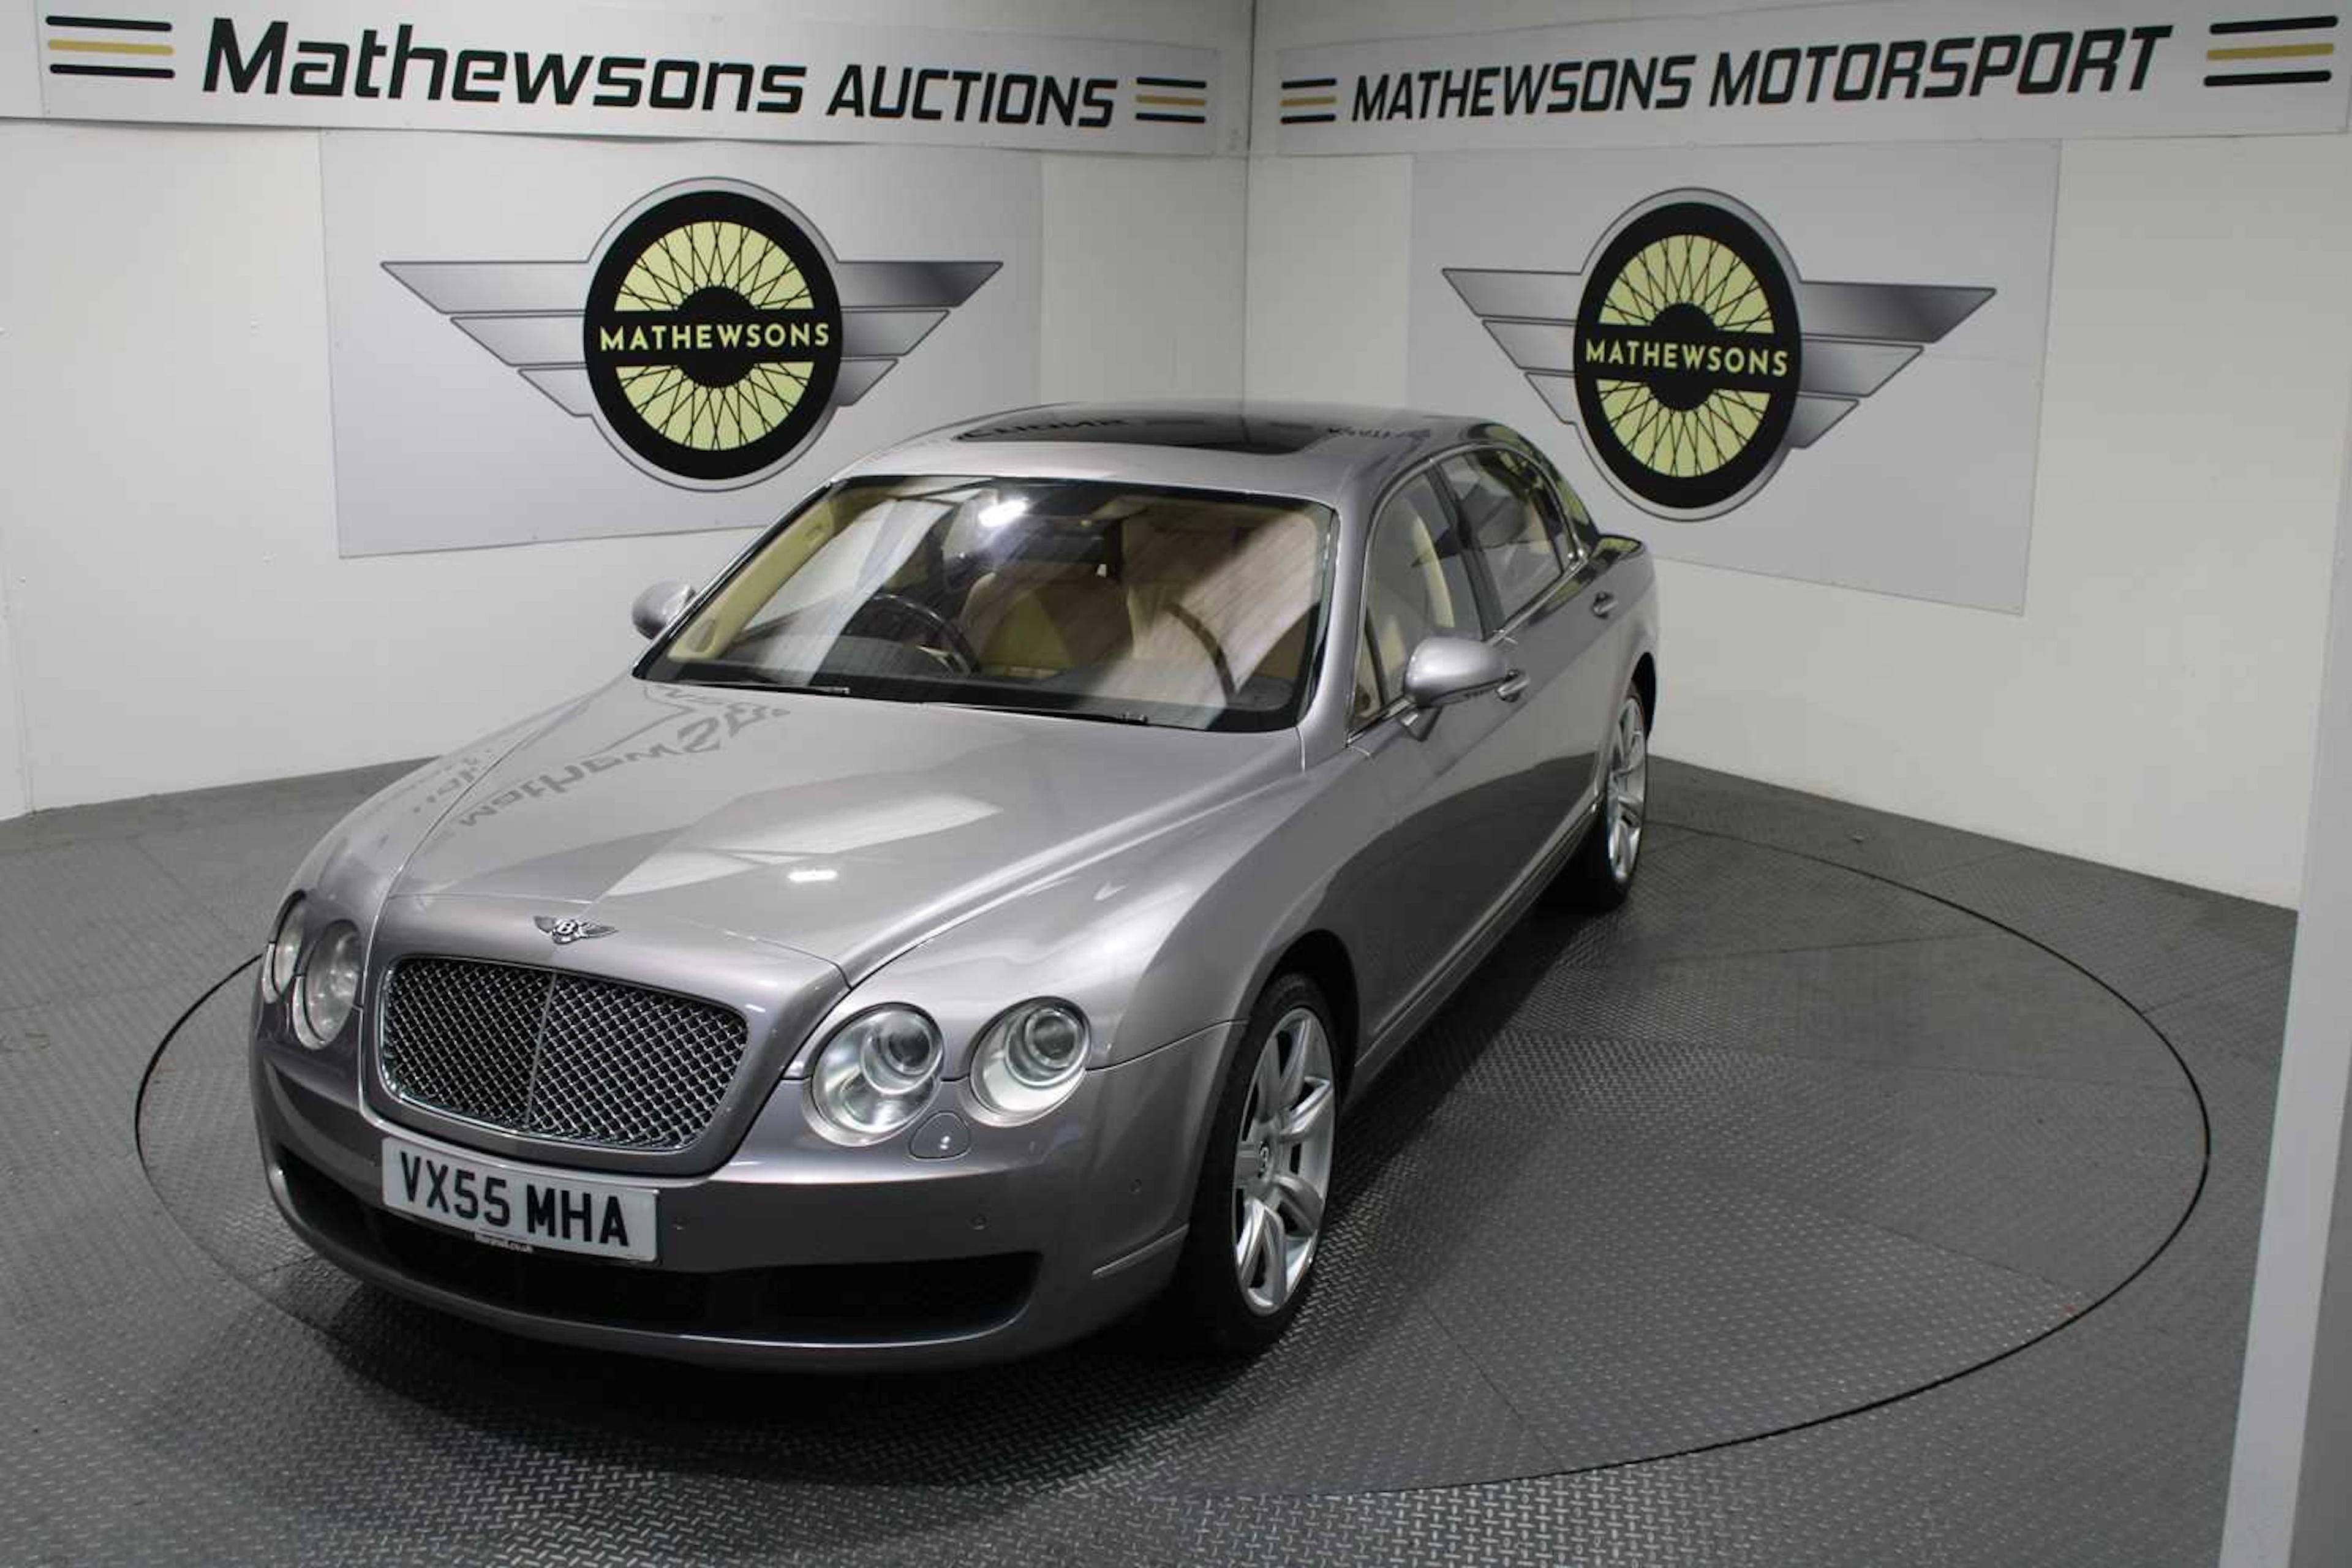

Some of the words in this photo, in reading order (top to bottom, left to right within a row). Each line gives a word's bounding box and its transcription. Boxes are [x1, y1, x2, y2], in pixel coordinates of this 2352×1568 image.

[203, 18, 806, 113] Mathewsons
[826, 65, 1118, 128] AUCTIONS
[1352, 56, 1695, 121] MATHEWSONS
[1710, 25, 2173, 106] MOTORSPORT
[600, 323, 829, 351] MATHEWSONS
[1586, 339, 1788, 377] MATHEWSONS
[401, 1152, 510, 1227] VX55
[527, 1183, 629, 1247] MHA
